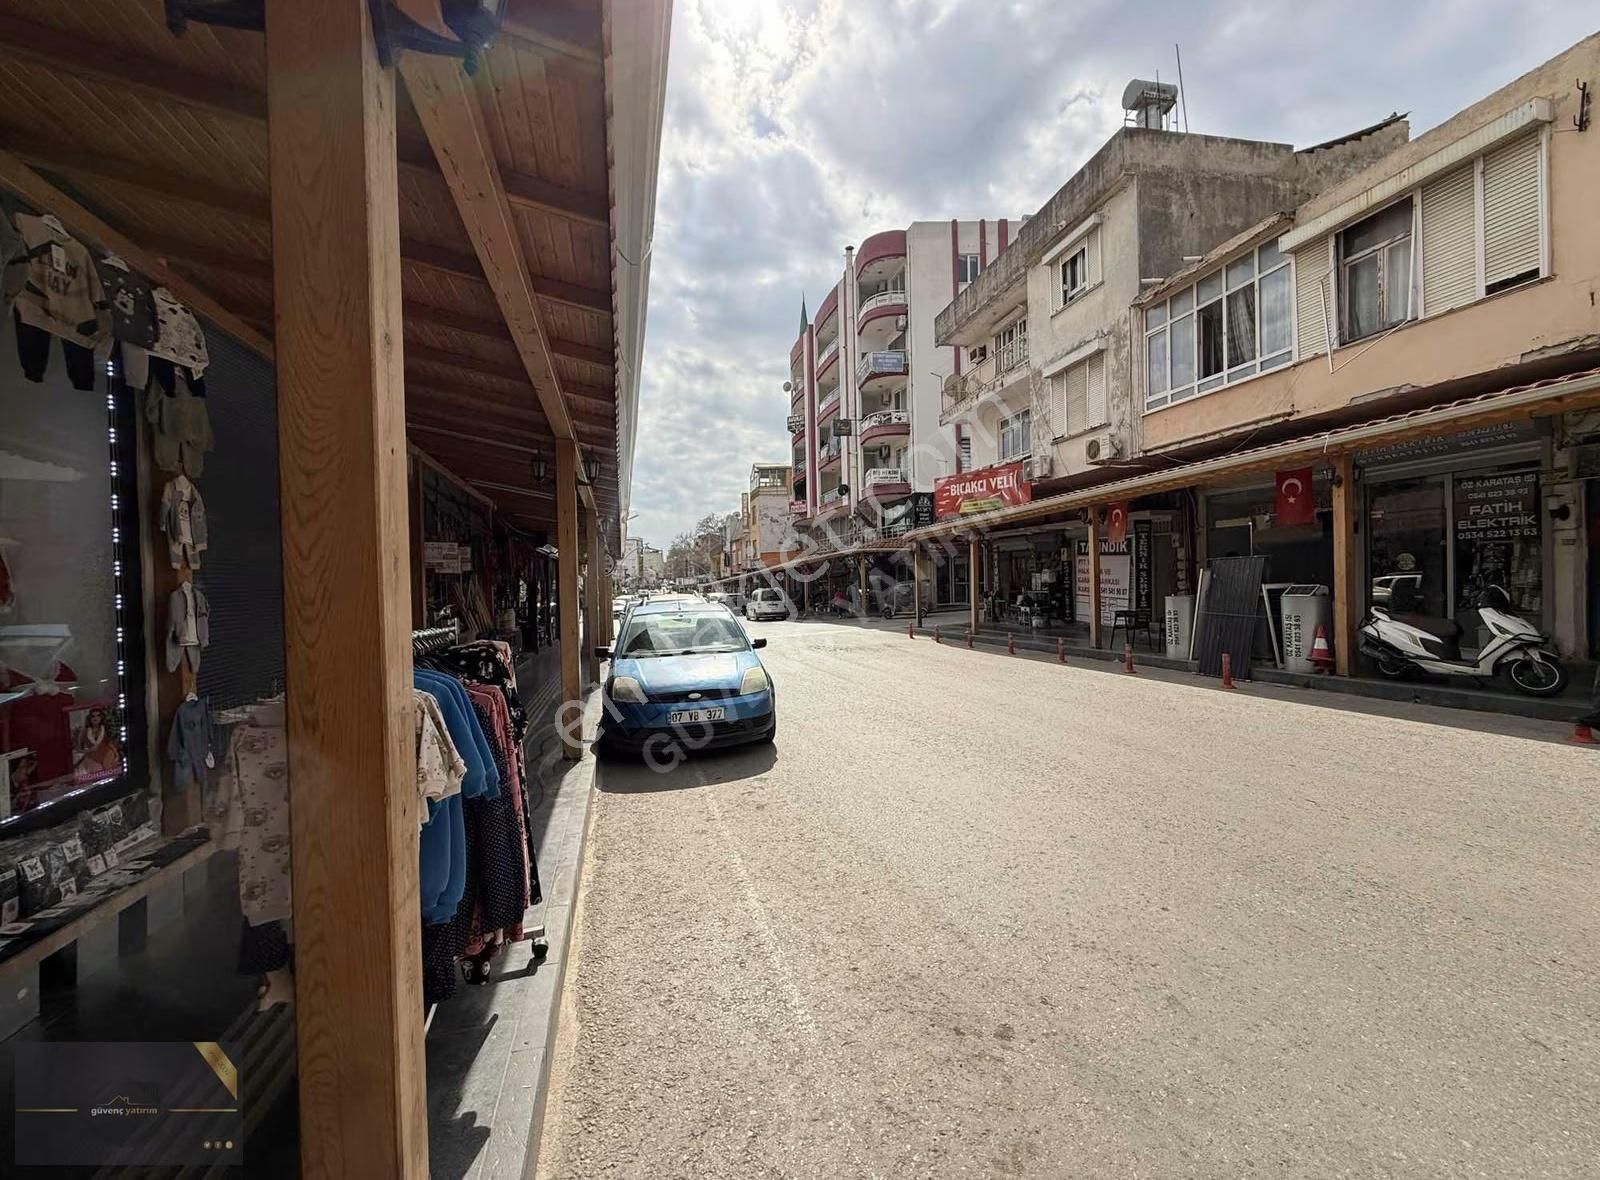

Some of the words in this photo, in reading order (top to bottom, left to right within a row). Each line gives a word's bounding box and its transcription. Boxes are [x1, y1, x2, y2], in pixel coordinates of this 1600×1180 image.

[989, 472, 1014, 490] VELİ
[1469, 499, 1522, 515] FATİH
[1458, 513, 1537, 529] ELEKTRİK
[1457, 531, 1484, 540] 0534
[1486, 530, 1506, 538] 522
[1079, 541, 1128, 553] TAINDIK
[671, 712, 683, 722] 07
[688, 711, 700, 721] VB
[706, 709, 722, 720] 377
